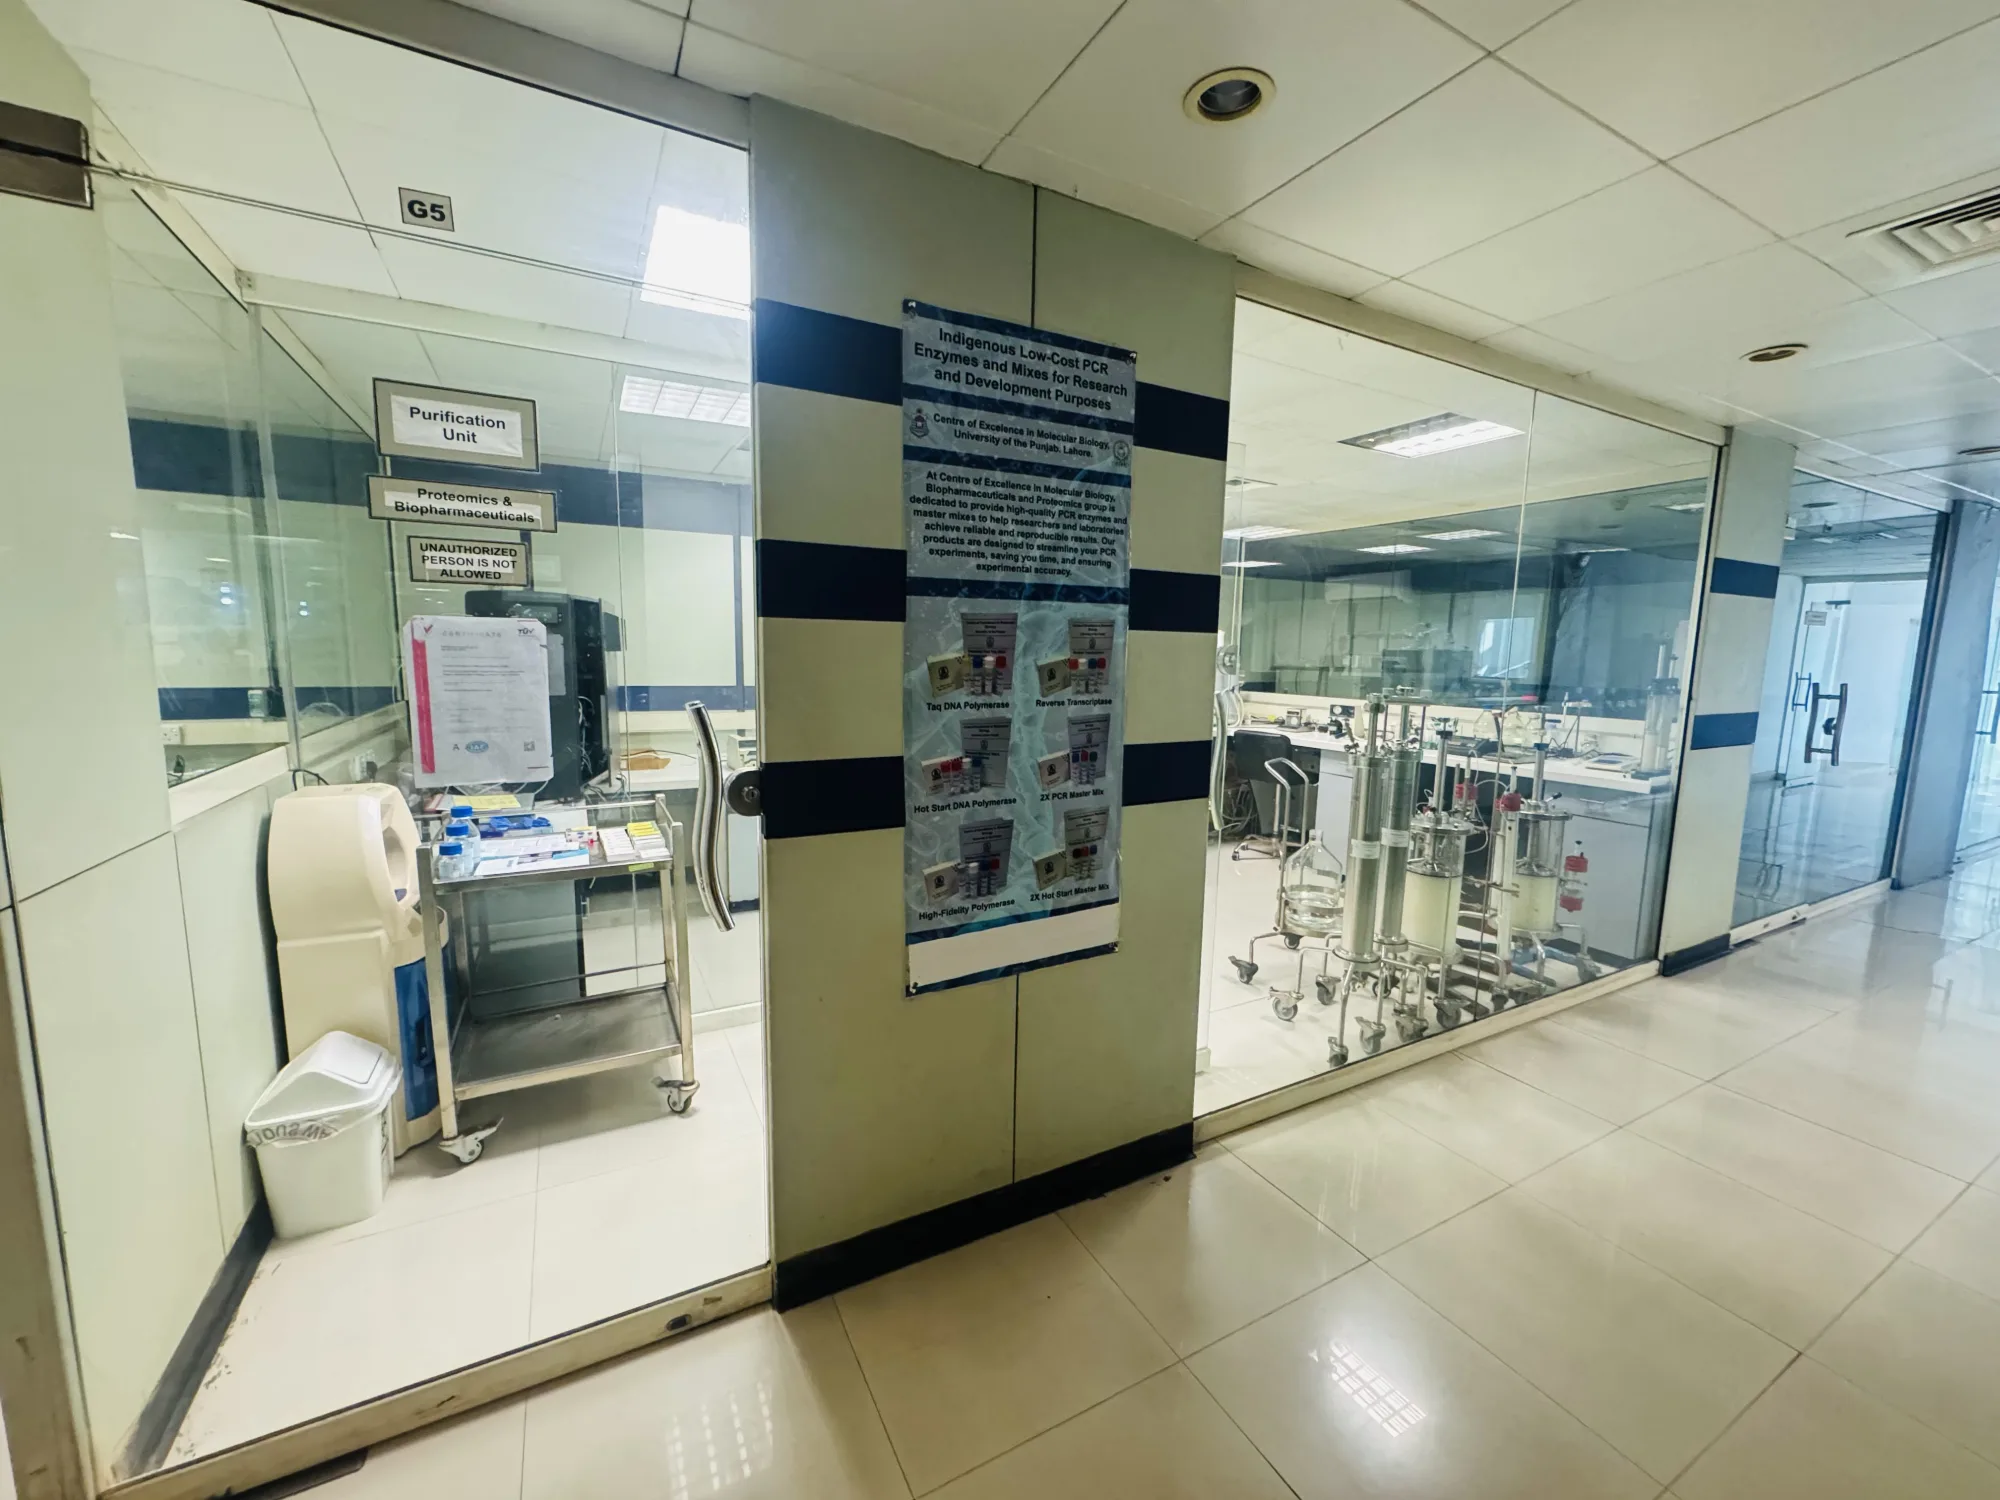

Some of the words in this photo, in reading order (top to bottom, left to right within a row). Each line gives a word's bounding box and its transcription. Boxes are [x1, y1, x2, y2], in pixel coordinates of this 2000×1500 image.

[407, 200, 446, 222] G5
[940, 328, 1016, 355] Indigenous
[1020, 345, 1080, 369] Low-Cost
[1083, 359, 1108, 375] PCR
[915, 342, 978, 367] Enzymes
[983, 359, 1007, 373] and
[1012, 362, 1048, 381] Mixes
[1052, 371, 1069, 384] for
[1073, 375, 1127, 397] Research
[934, 369, 960, 383] and
[965, 372, 1051, 400] Development
[1055, 389, 1111, 411] Purposes
[410, 406, 506, 430] Purification
[933, 413, 965, 426] Centre
[967, 420, 977, 428] of
[1026, 428, 1034, 436] in
[1037, 429, 1077, 444] Molecular
[443, 428, 478, 444] Unit
[954, 429, 1000, 446] University
[1003, 437, 1012, 446] of
[1014, 439, 1027, 448] the
[926, 471, 937, 480] At
[939, 472, 970, 484] Centre
[973, 477, 982, 485] of
[984, 478, 1031, 491] Excellence
[1034, 484, 1041, 492] in
[1044, 485, 1083, 498] Molecular
[417, 488, 498, 506] Proteomics
[503, 496, 513, 507] &
[926, 483, 1016, 502] Biopharmaceuticals
[1018, 495, 1034, 504] and
[1036, 495, 1082, 509] Proteomics
[1084, 503, 1107, 513] group
[1109, 504, 1116, 512] is
[394, 501, 535, 523] Biopharmaceuticals
[909, 495, 957, 508] dedicated
[959, 500, 968, 509] to
[970, 502, 1004, 512] provide
[1007, 505, 1056, 519] high-quality
[1058, 510, 1076, 520] PCR
[1078, 513, 1112, 523] enzymes
[1113, 517, 1128, 525] and
[913, 509, 947, 519] master
[949, 512, 976, 521] mixes
[978, 515, 988, 523] to
[990, 515, 1009, 526] help
[1011, 518, 1060, 530] researchers
[1062, 523, 1077, 531] and
[1079, 524, 1125, 536] laboratories
[924, 522, 961, 533] achieve
[963, 524, 996, 535] reliable
[998, 529, 1015, 537] and
[1017, 531, 1069, 542] reproducible
[1101, 537, 1116, 546] Our
[419, 543, 517, 557] UNAUTHORIZED
[923, 535, 965, 545] products
[984, 539, 1024, 550] designed
[1036, 543, 1079, 554] streamline
[1080, 547, 1098, 556] your
[1100, 547, 1117, 557] PCR
[422, 555, 474, 567] PERSON
[477, 559, 489, 568] IS
[492, 560, 517, 569] NOT
[929, 548, 988, 560] experiments,
[990, 552, 1019, 563] saving
[1020, 555, 1037, 564] you
[1061, 557, 1076, 565] and
[1078, 559, 1112, 569] ensuring
[976, 563, 1032, 573] experimental
[440, 569, 502, 580] ALLOWED
[926, 702, 942, 712] Taq
[944, 702, 962, 711] DNA
[964, 701, 1010, 711] Polymerase
[1036, 699, 1065, 707] Reverse
[914, 805, 929, 814] Hot
[931, 803, 951, 812] Start
[953, 801, 971, 810] DNA
[972, 798, 1017, 808] Polymerase
[1040, 793, 1050, 802] 2X
[1052, 792, 1068, 801] PCR
[1030, 893, 1040, 902] 2X
[1041, 892, 1055, 900] Hot
[1056, 889, 1073, 898] Start
[919, 906, 970, 921] High-Fidelity
[971, 899, 1015, 912] Polymerase
